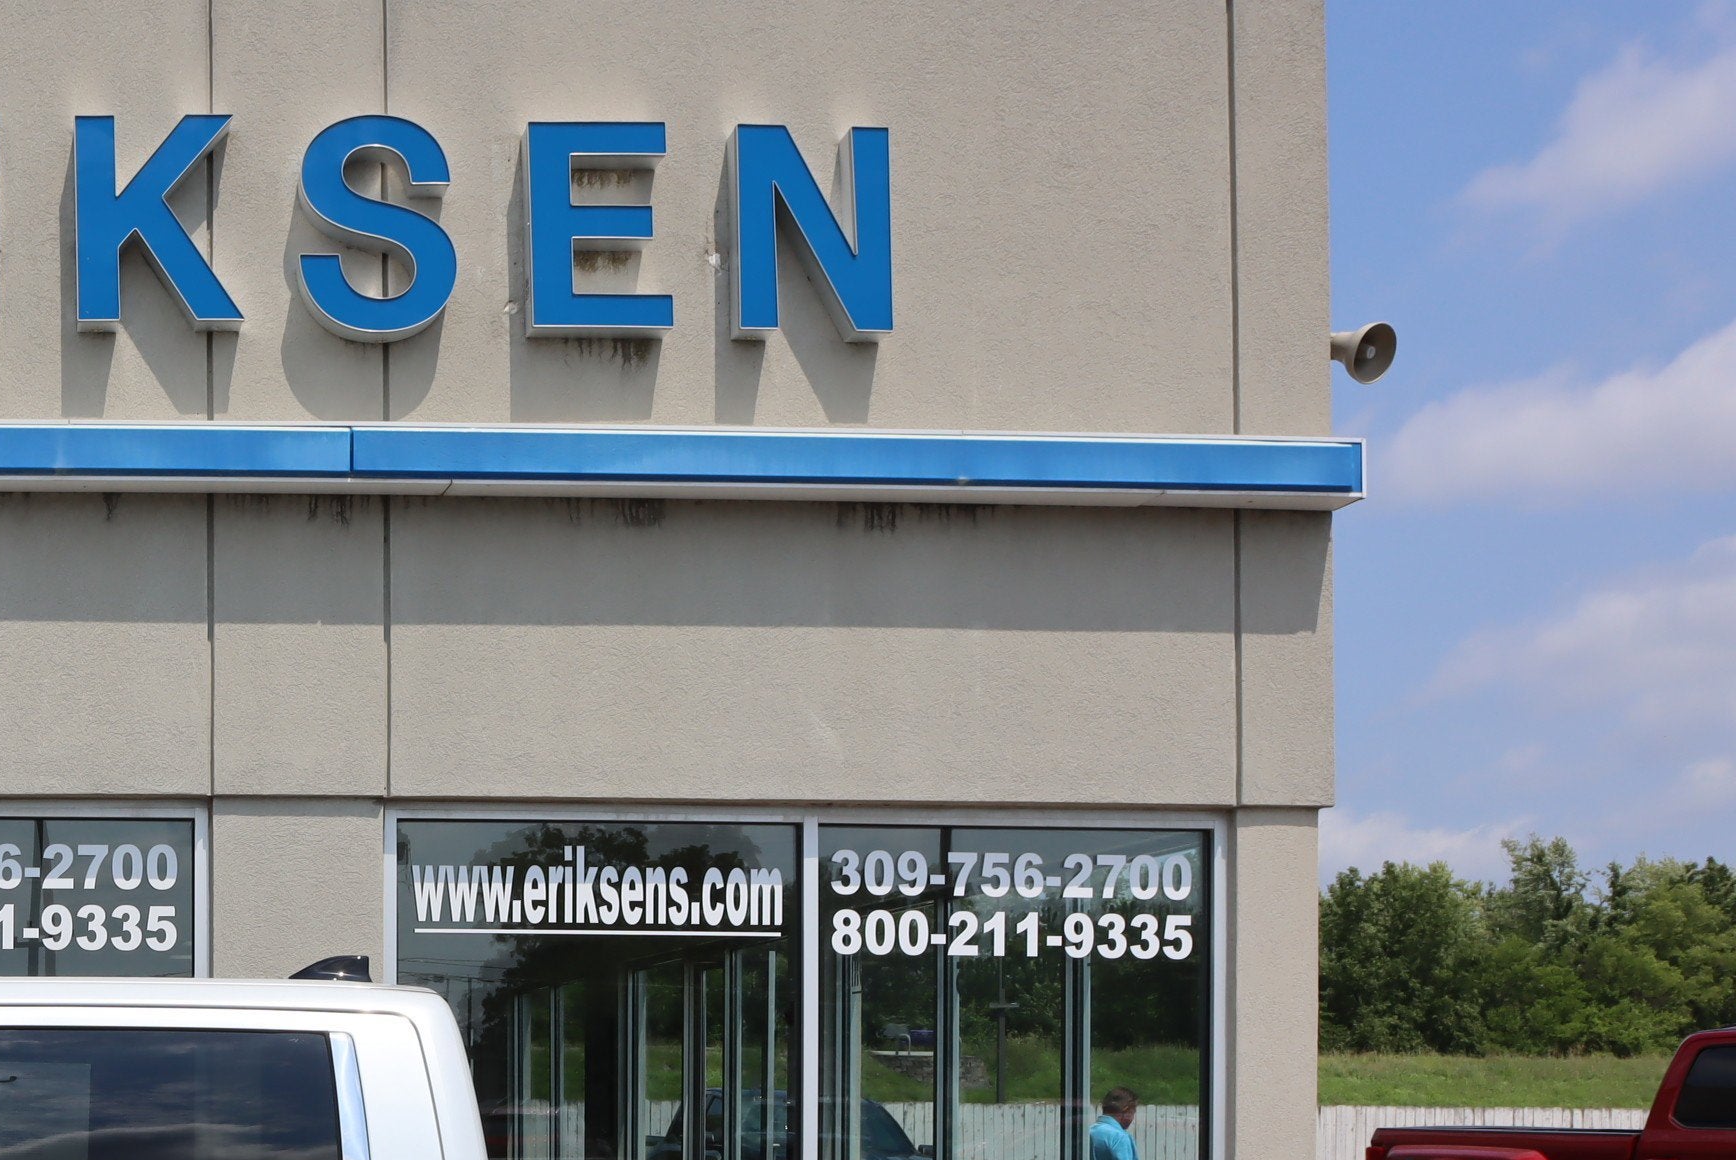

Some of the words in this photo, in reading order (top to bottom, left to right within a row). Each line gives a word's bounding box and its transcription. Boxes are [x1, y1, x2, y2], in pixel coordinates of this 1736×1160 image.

[412, 845, 784, 927] www.eriksens.com
[830, 848, 1194, 901] 309-756-2700
[830, 908, 1194, 960] 800-211-9335
